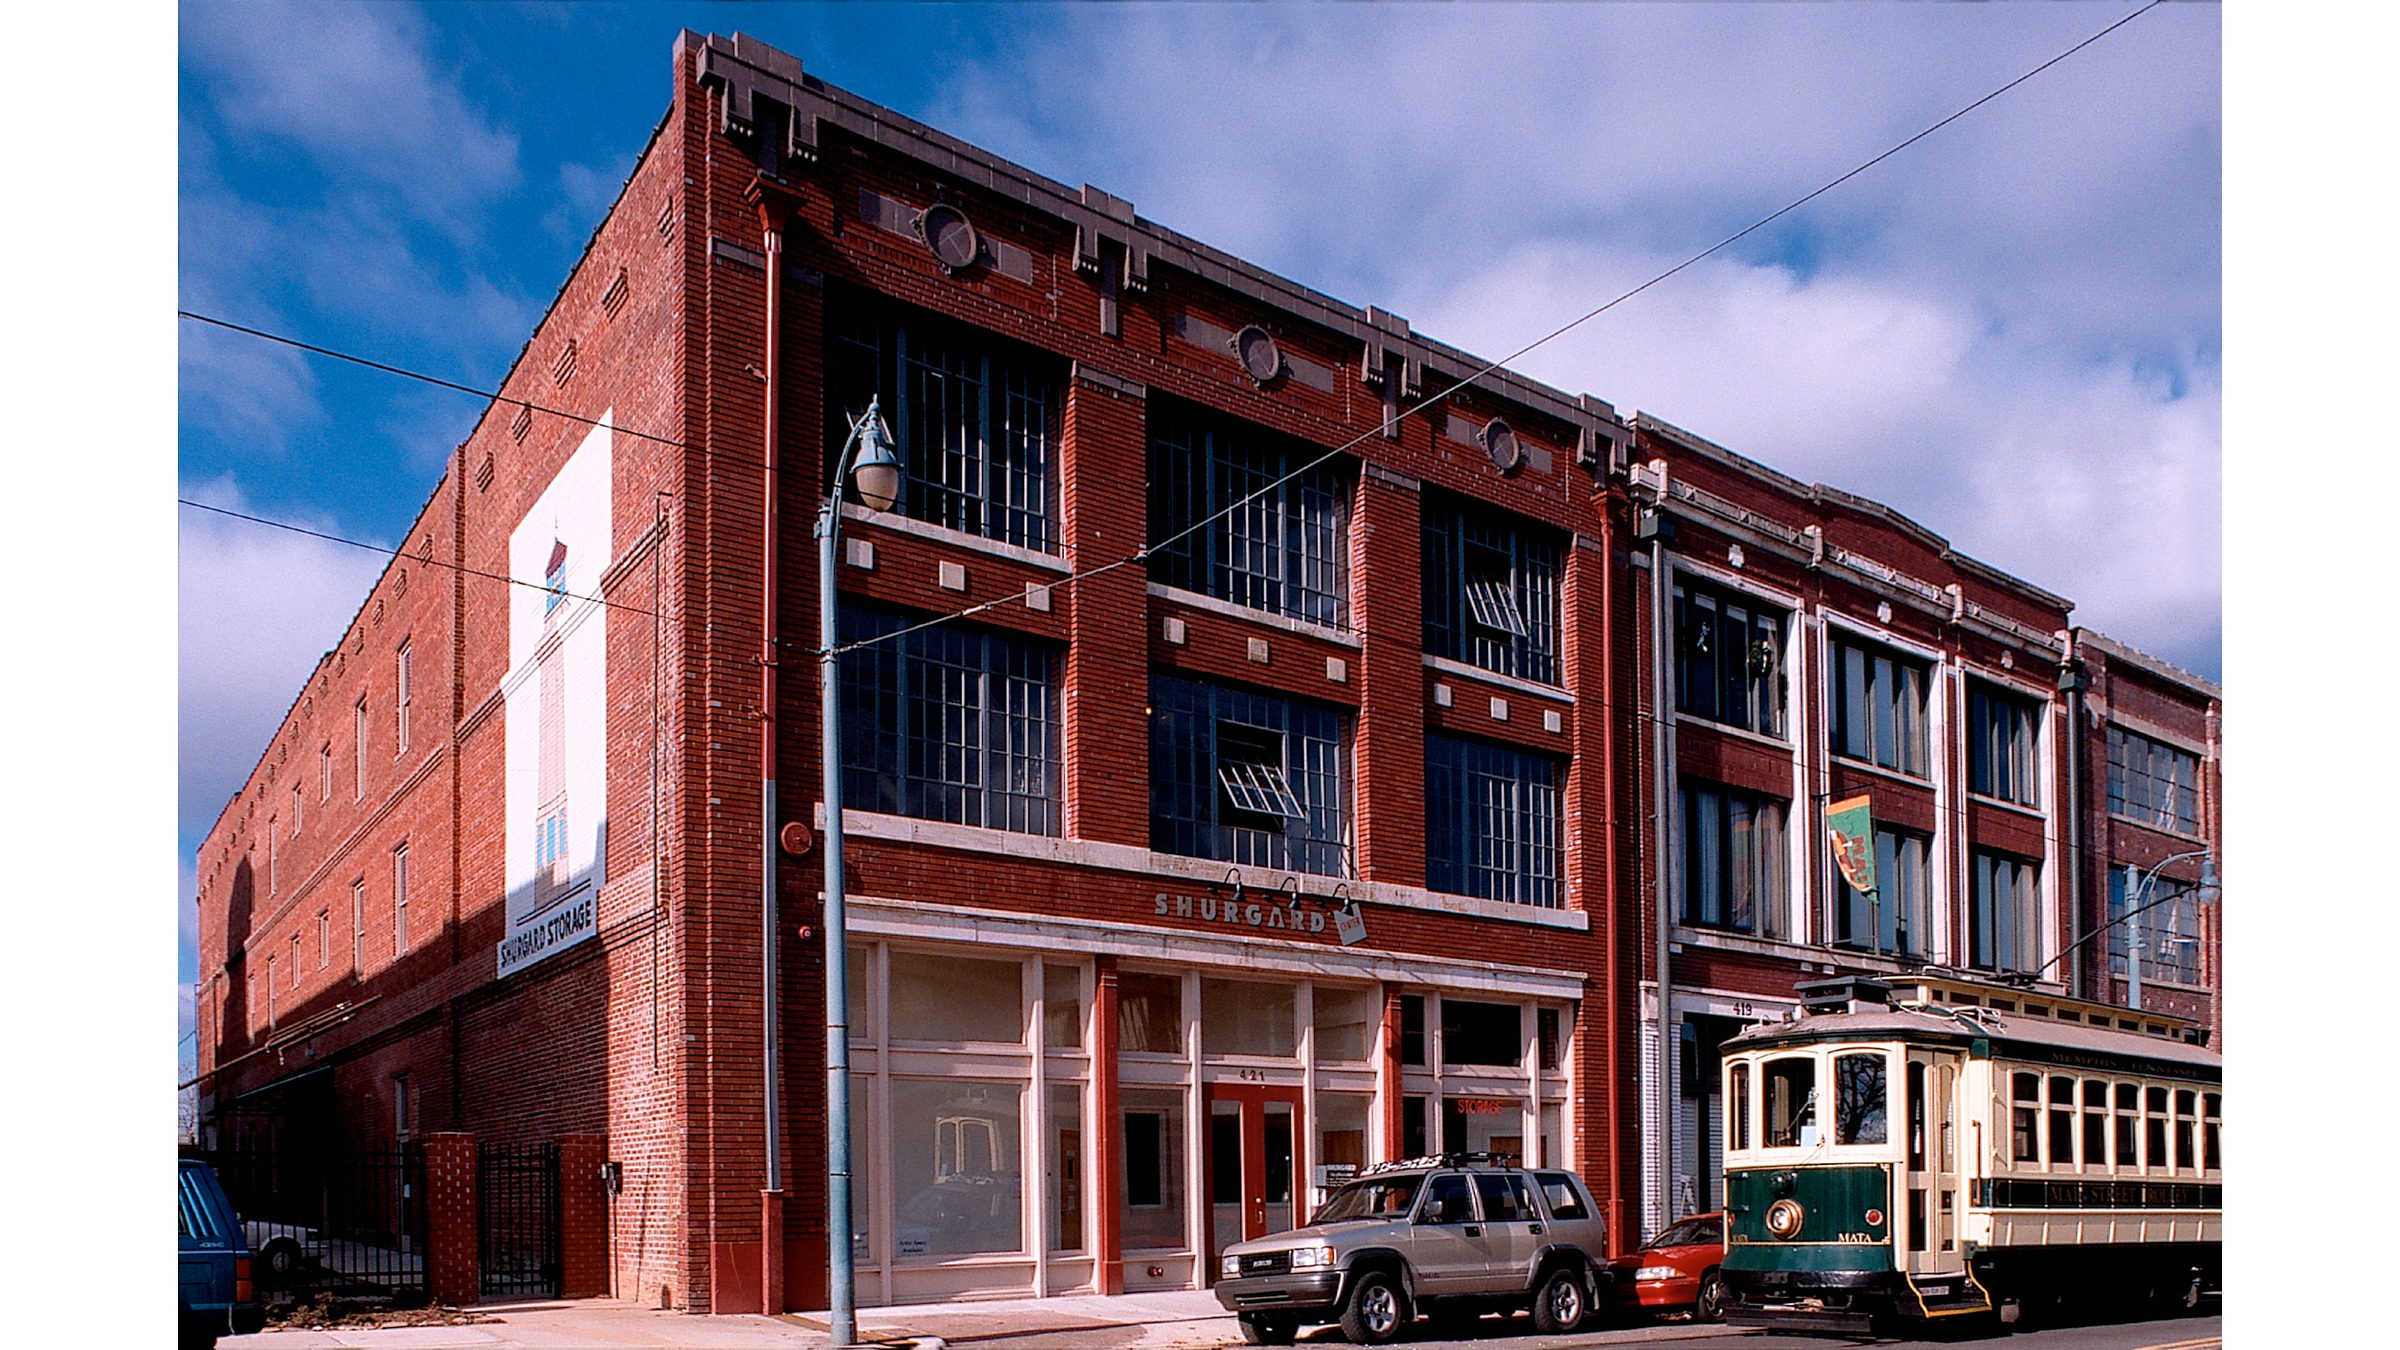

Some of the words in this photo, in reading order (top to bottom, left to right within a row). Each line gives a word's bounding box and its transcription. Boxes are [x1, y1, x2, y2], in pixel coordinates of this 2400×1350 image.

[1154, 893, 1326, 933] SHURGARD
[501, 924, 546, 968] SHURGARD
[547, 900, 591, 946] STORAGE
[1733, 1002, 1752, 1016] 419
[1240, 1069, 1264, 1081] 421
[1457, 1099, 1503, 1116] STORAGE
[2091, 1186, 2136, 1203] STREET
[1838, 1232, 1873, 1243] MATA
